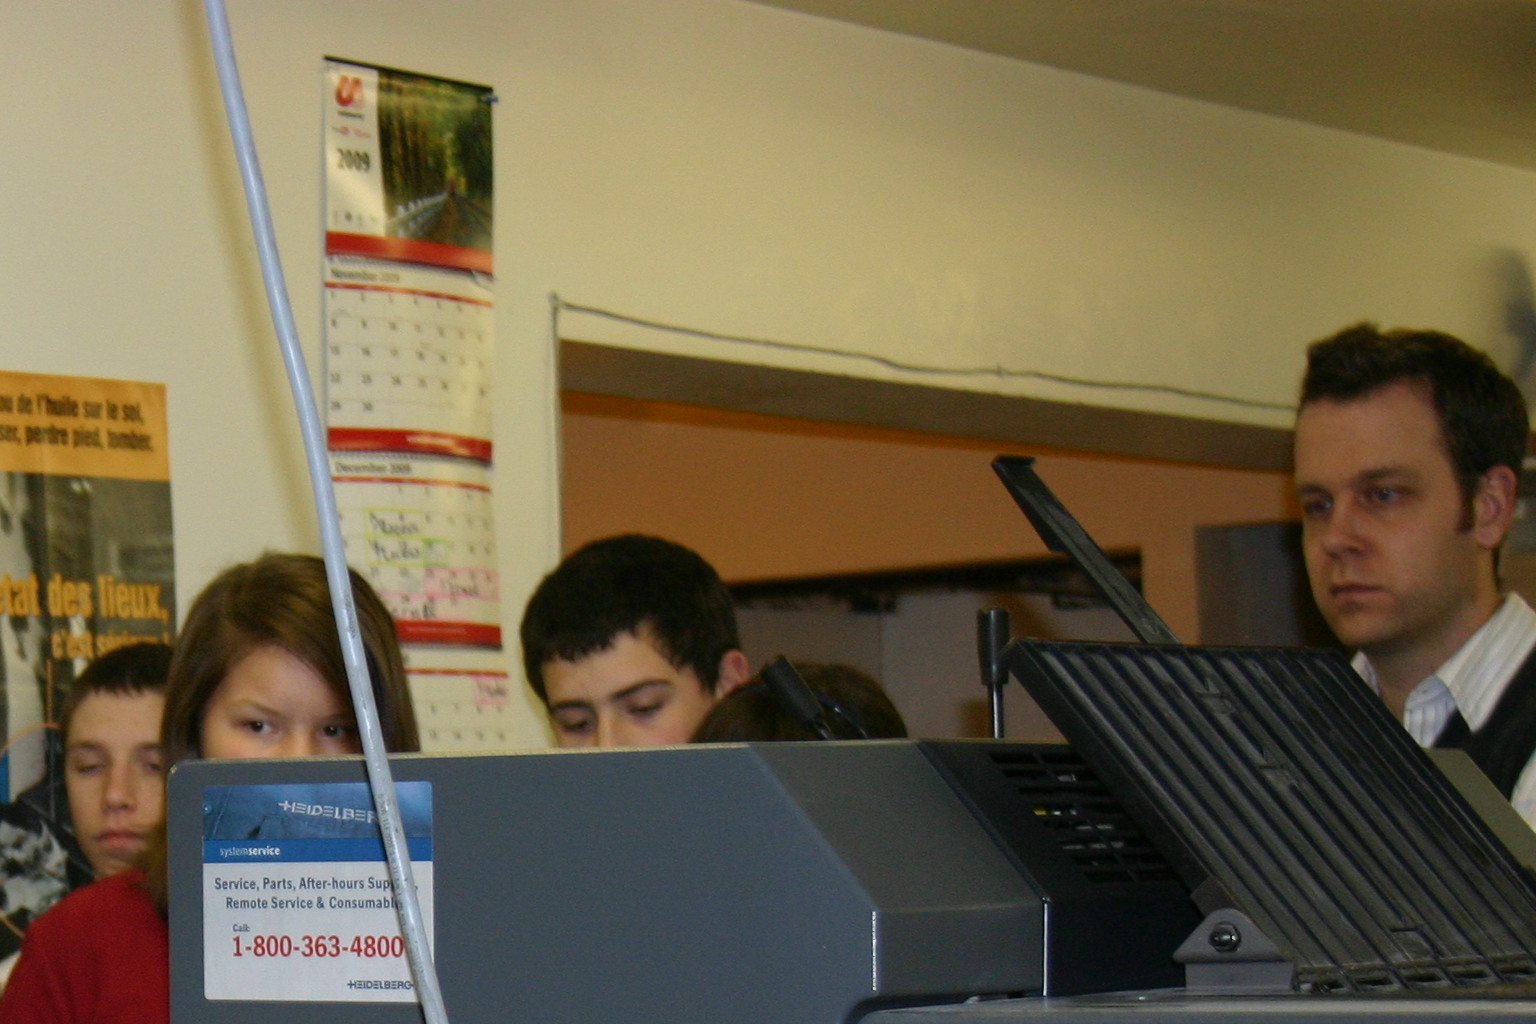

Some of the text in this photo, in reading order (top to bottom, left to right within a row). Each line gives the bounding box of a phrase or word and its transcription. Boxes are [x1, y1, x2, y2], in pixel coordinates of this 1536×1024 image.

[337, 148, 371, 172] 2009
[36, 392, 79, 417] l'huile
[83, 401, 102, 419] sur
[107, 399, 118, 420] le
[122, 402, 144, 425] sol,
[25, 423, 69, 447] perdre
[72, 427, 104, 449] pied,
[334, 462, 387, 473] December
[47, 575, 93, 617] des
[98, 575, 170, 624] lieux,
[51, 628, 94, 660] c'est
[220, 845, 281, 858] systemservice
[215, 877, 260, 891] Service,
[263, 877, 296, 891] Parts,
[299, 876, 365, 890] After-hours
[226, 896, 397, 909] Remote Service & Consumabl
[232, 923, 250, 932] Call:
[232, 935, 406, 958] 1-800-363-4800
[347, 979, 414, 990] HEIDELBERG
